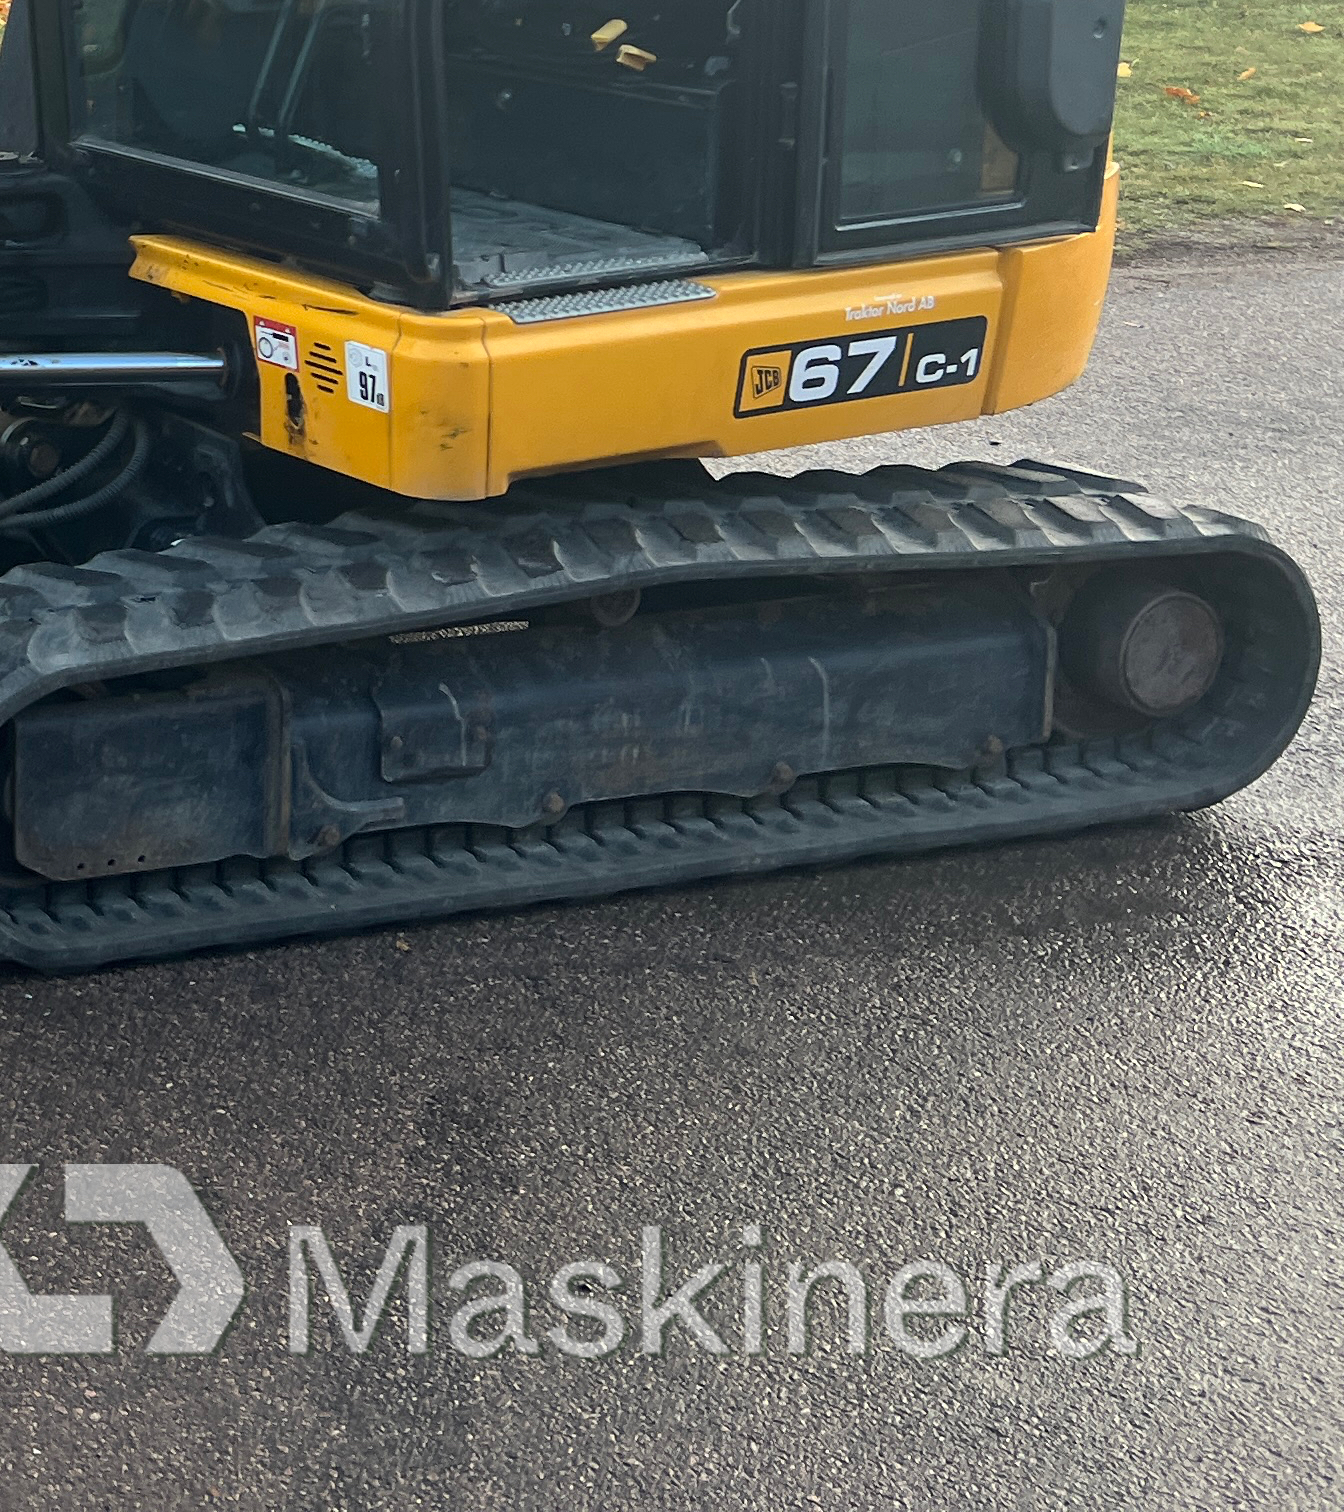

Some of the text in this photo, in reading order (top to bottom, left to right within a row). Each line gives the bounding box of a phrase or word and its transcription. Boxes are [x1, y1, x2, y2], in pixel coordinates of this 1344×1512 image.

[844, 302, 885, 322] Traktor
[886, 296, 916, 315] Nord
[918, 295, 935, 311] AB
[755, 335, 979, 403] JCB 67 C-1
[358, 370, 377, 403] 97
